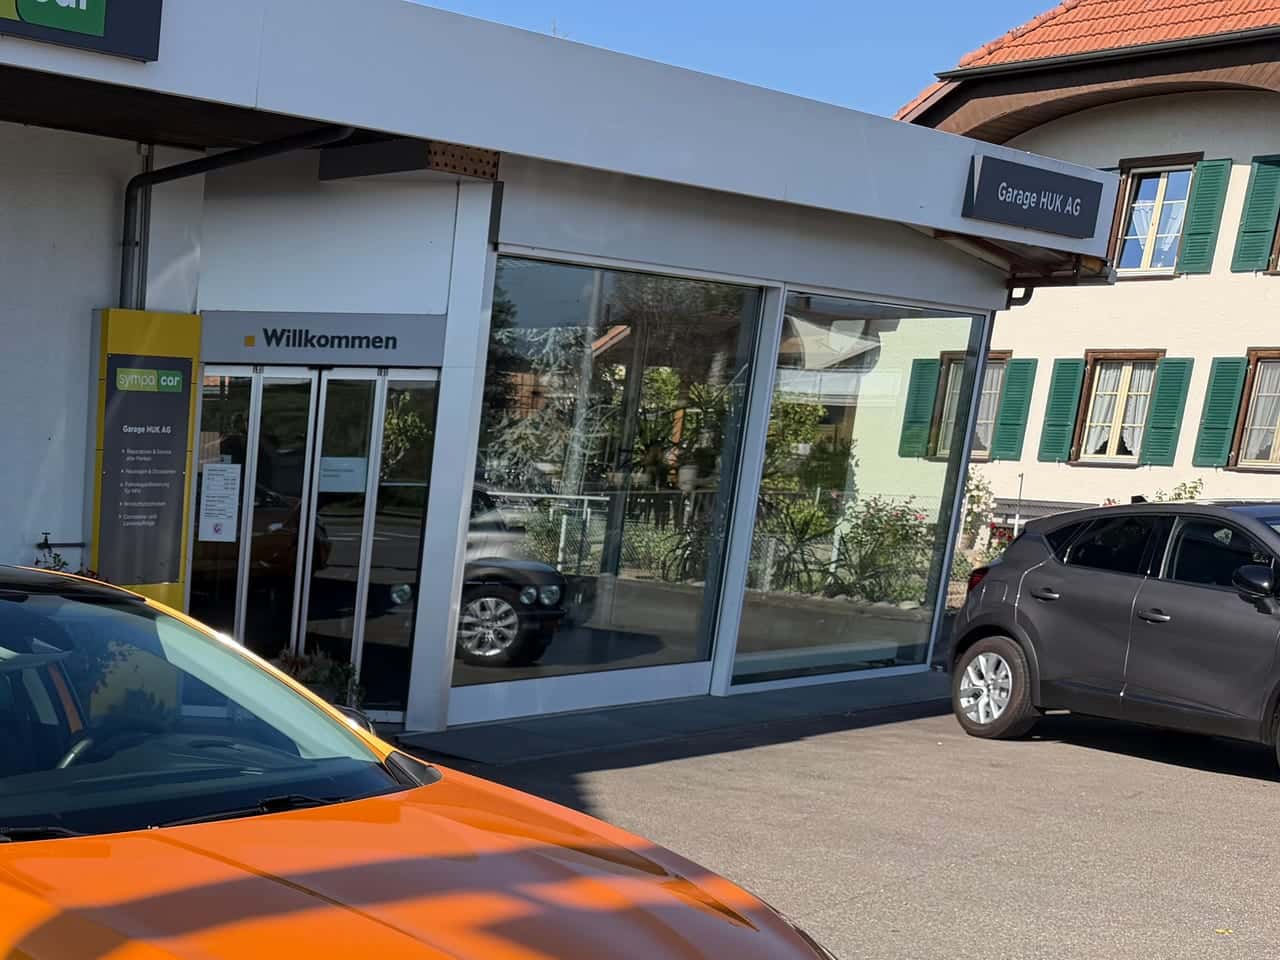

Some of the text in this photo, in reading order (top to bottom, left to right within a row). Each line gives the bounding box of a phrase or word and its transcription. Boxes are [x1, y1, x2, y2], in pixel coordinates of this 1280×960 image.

[998, 182, 1081, 216] Garage HUK AG
[262, 327, 398, 350] Willkommen
[119, 373, 181, 389] sympa car
[122, 424, 145, 434] Garage
[161, 425, 172, 434] AG
